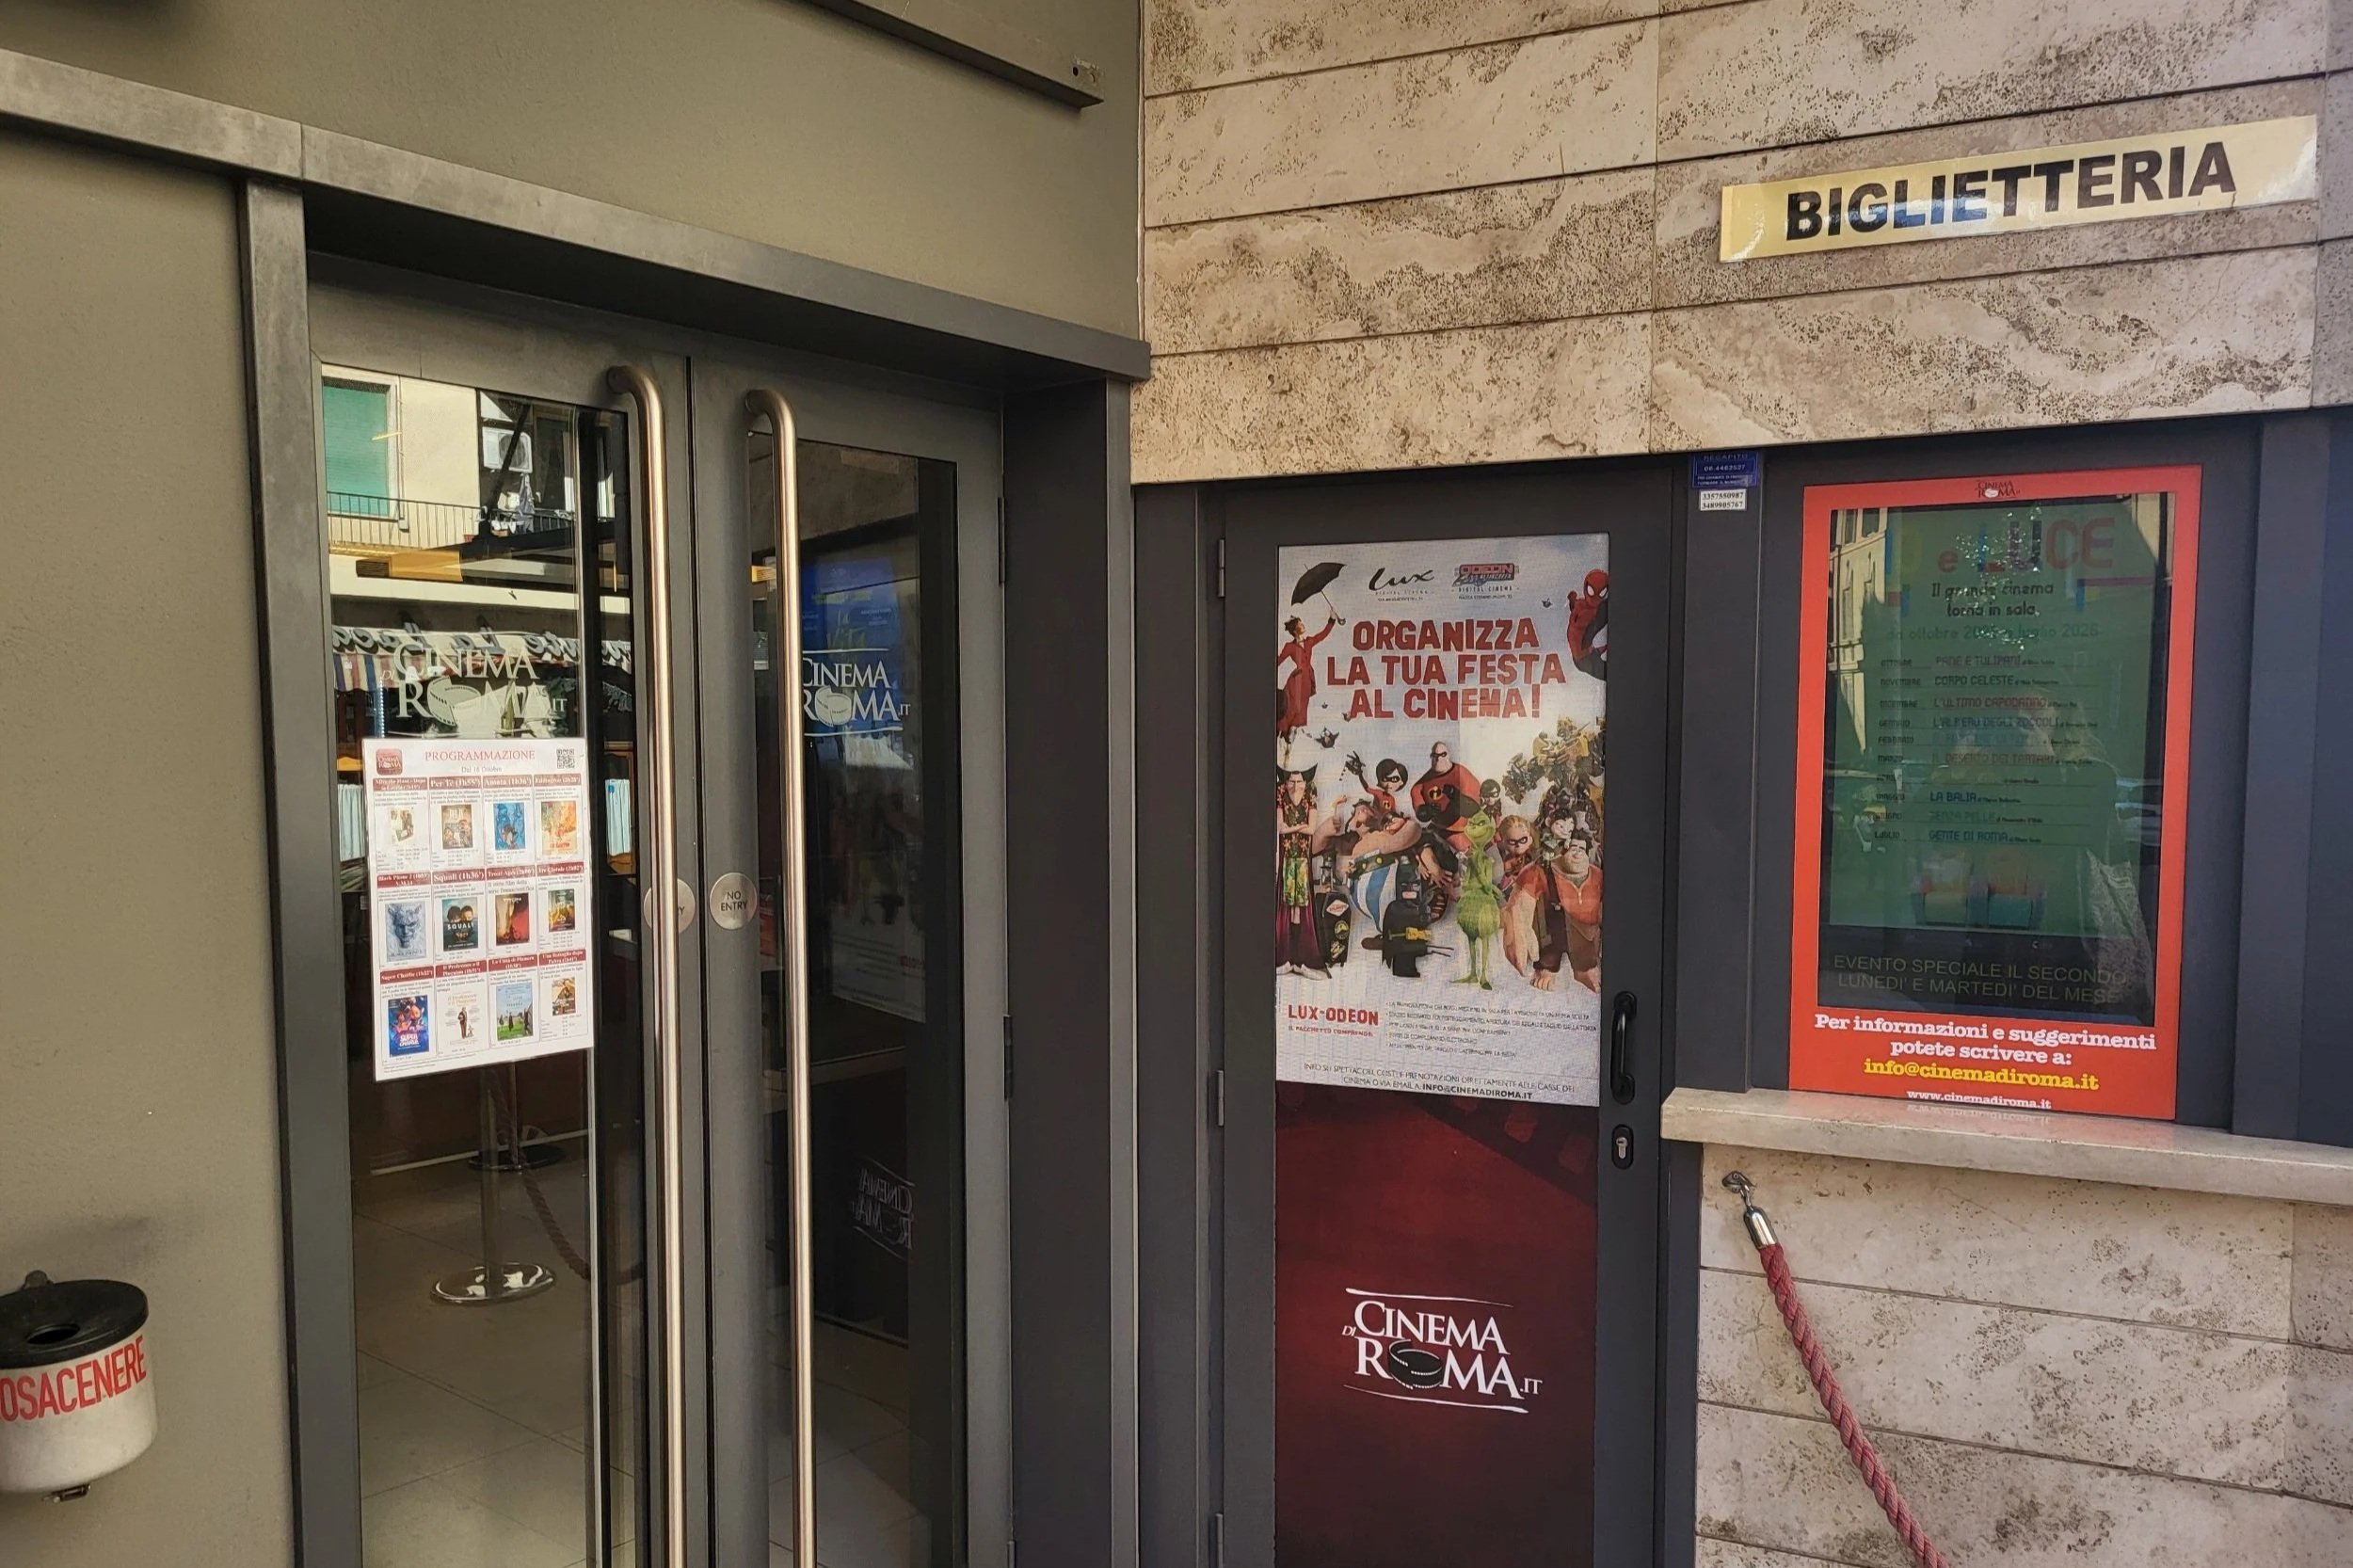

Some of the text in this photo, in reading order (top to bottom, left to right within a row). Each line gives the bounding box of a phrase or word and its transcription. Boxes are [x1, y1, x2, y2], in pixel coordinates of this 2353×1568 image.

[1785, 141, 2236, 241] BIGLIETTERIA
[1978, 481, 2013, 489] CINEMA
[2002, 581, 2054, 595] cinema
[1989, 602, 2001, 616] in
[1353, 617, 1540, 651] ORGANIZZA
[393, 642, 540, 680] CINEMA
[803, 657, 891, 689] CINEMA
[1327, 653, 1566, 686] LA TUA FESTA
[1971, 675, 2014, 685] CELESTE
[1351, 684, 1541, 720] AL CINEMA!
[424, 749, 536, 761] PROGRAMMAZIONE
[721, 901, 748, 912] ENTRY
[727, 891, 741, 900] NO
[1835, 955, 2127, 985] EVENTO SPECIALE IL SECONDO
[1838, 973, 2117, 1004] LUNEDI' E MARTEDI' DEL MESE
[1288, 1004, 1379, 1026] LUX-ODEON
[1295, 1026, 1332, 1034] PACCHETTO
[1814, 1014, 2157, 1050] Per informazioni e suggerimenti
[1890, 1038, 2072, 1066] potete scrivere a:
[1864, 1058, 2099, 1091] info@cinemadiroma.it
[1344, 1077, 1370, 1085] CINEMA
[1422, 1083, 1532, 1099] INFO@CINEMADIROMA.IT
[1907, 1089, 2052, 1110] www.cinemadiroma.it
[1342, 1325, 1356, 1337] DI
[1354, 1300, 1511, 1355] CINEMA
